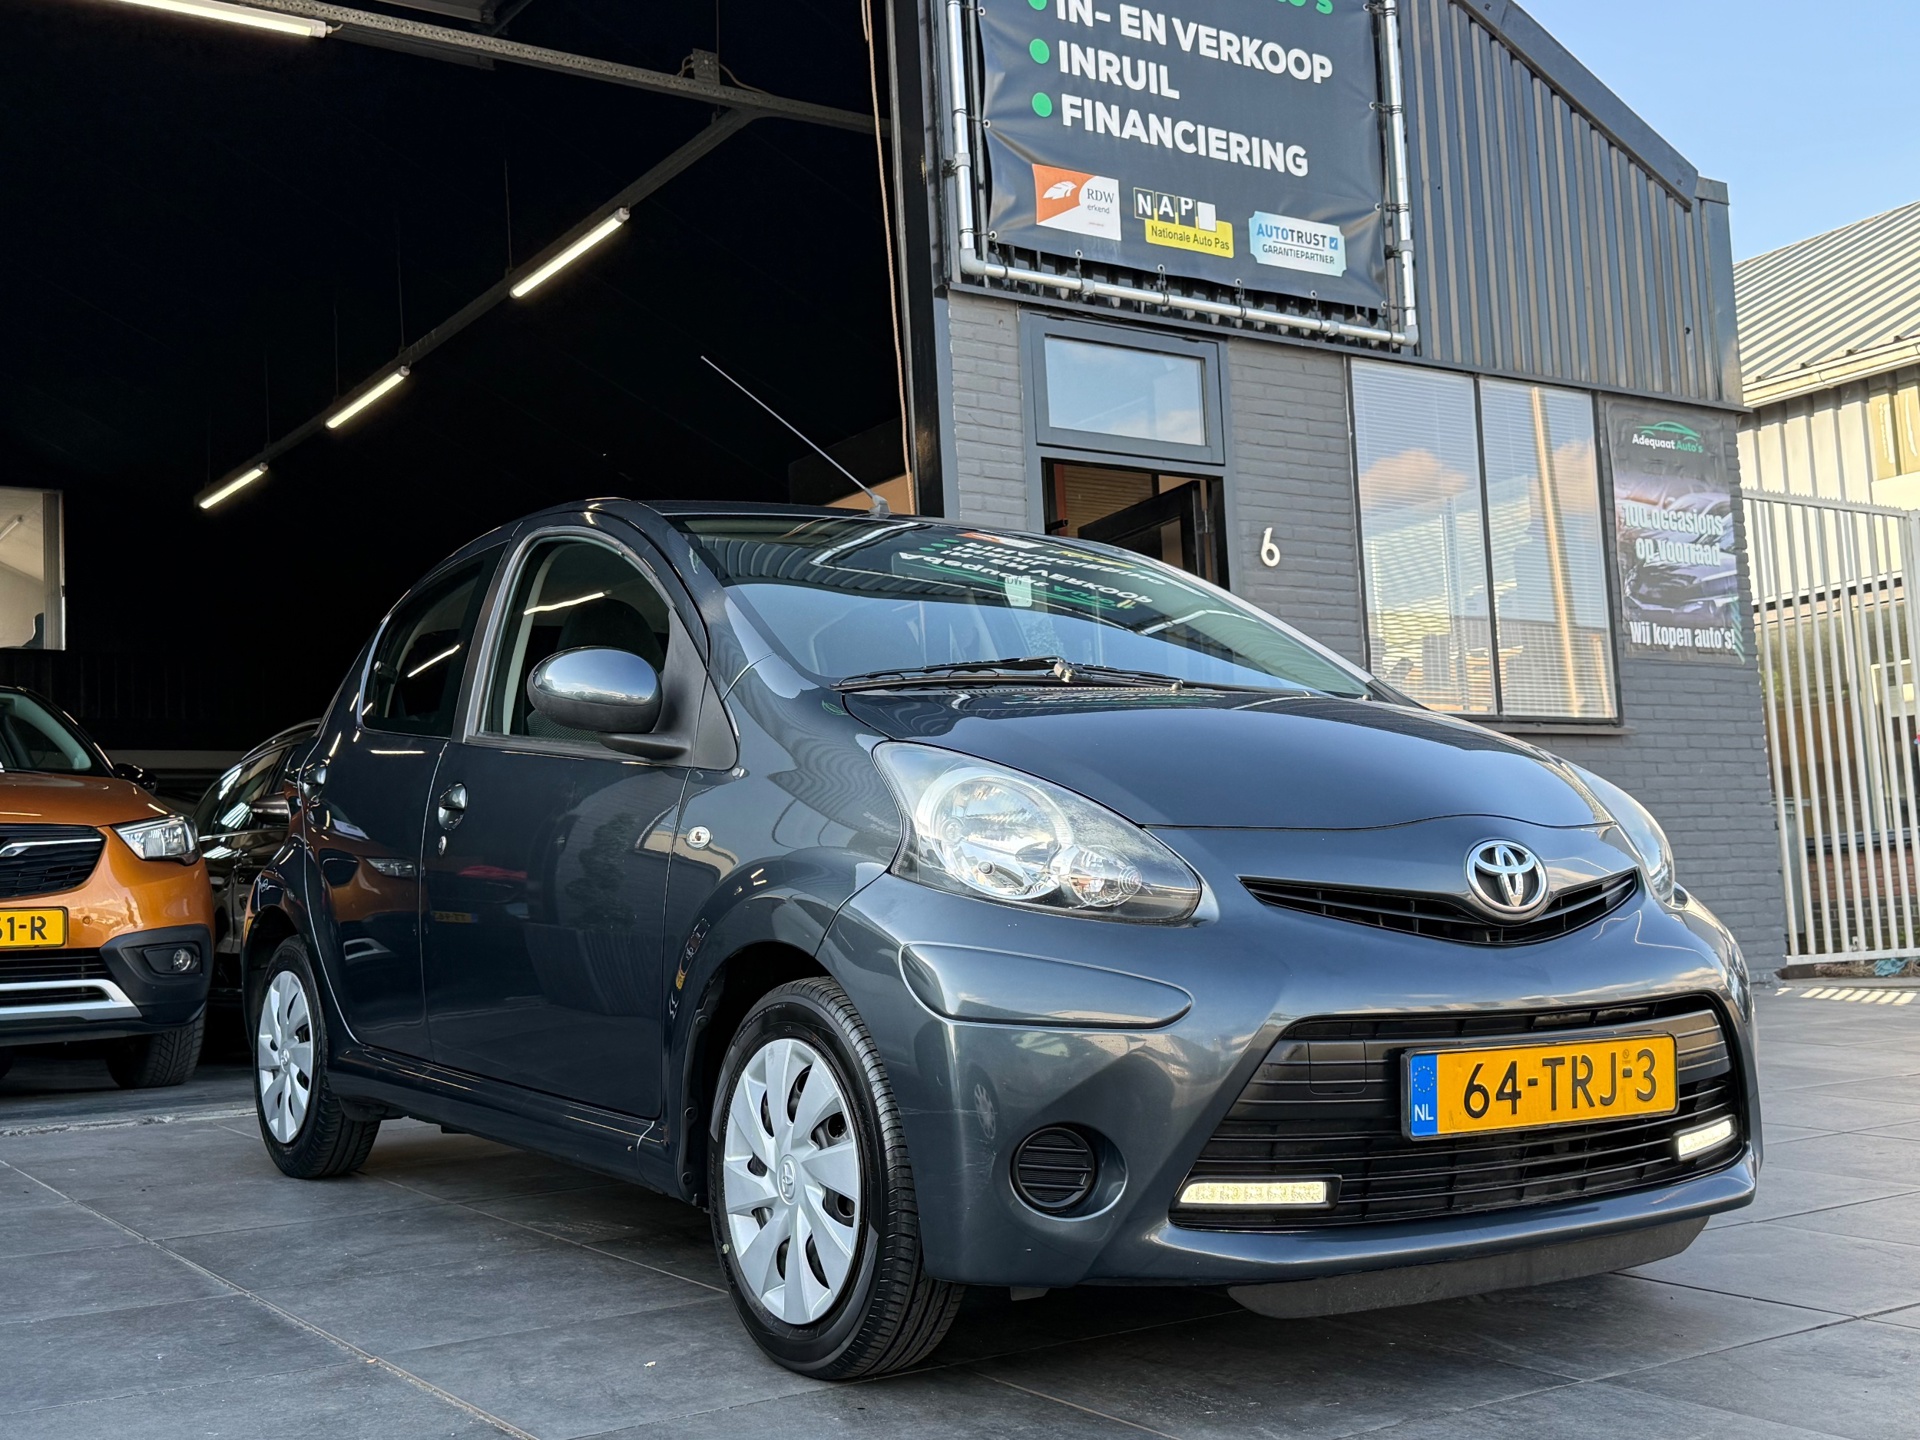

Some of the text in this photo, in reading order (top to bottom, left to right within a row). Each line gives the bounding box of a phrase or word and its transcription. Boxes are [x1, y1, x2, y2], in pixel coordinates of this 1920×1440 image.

[1056, 0, 1333, 84] IN- EN VERKOOP
[1058, 40, 1180, 100] INRUIL
[1061, 93, 1309, 177] FINANCIERING
[1087, 188, 1114, 204] RDW
[1087, 204, 1110, 214] erkend
[1137, 192, 1193, 218] NAP
[1151, 225, 1230, 250] Nationale Auto Pas
[1256, 223, 1327, 248] AUTOTRUST
[1262, 244, 1335, 264] GARANTIEPARTNER
[1631, 433, 1703, 453] Adequaat Auto's
[1622, 502, 1724, 536] 100 occasions
[1261, 527, 1280, 567] 6
[1635, 538, 1721, 567] op voorraad
[1629, 621, 1736, 650] Wij kopen auto's!
[0, 916, 48, 941] 1-R
[1463, 1048, 1657, 1119] 64-TRJ-3
[1414, 1104, 1434, 1121] NL
